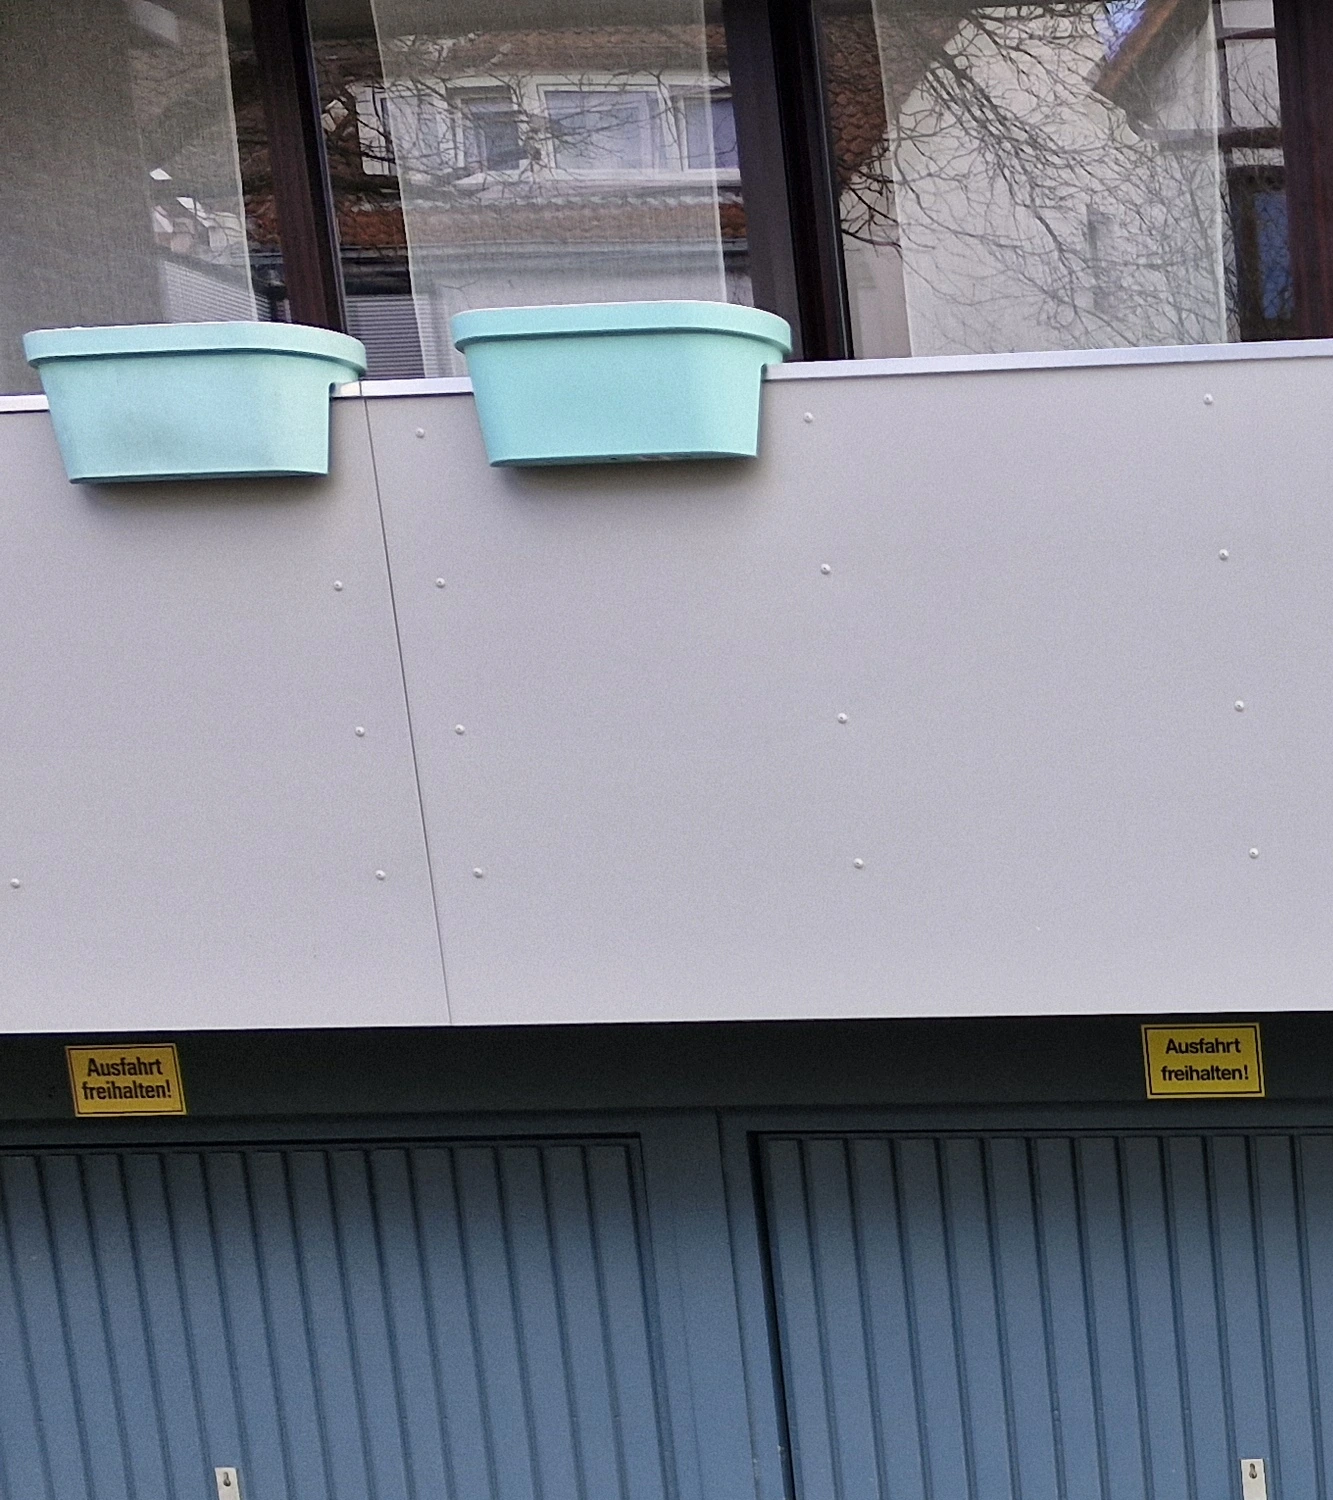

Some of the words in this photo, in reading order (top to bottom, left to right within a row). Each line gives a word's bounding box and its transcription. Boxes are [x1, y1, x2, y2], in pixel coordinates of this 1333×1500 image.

[1165, 1038, 1242, 1054] Ausfahrt
[87, 1056, 163, 1077] Ausfahrt
[1161, 1065, 1249, 1081] freihalten!
[82, 1079, 172, 1100] freihalten!
